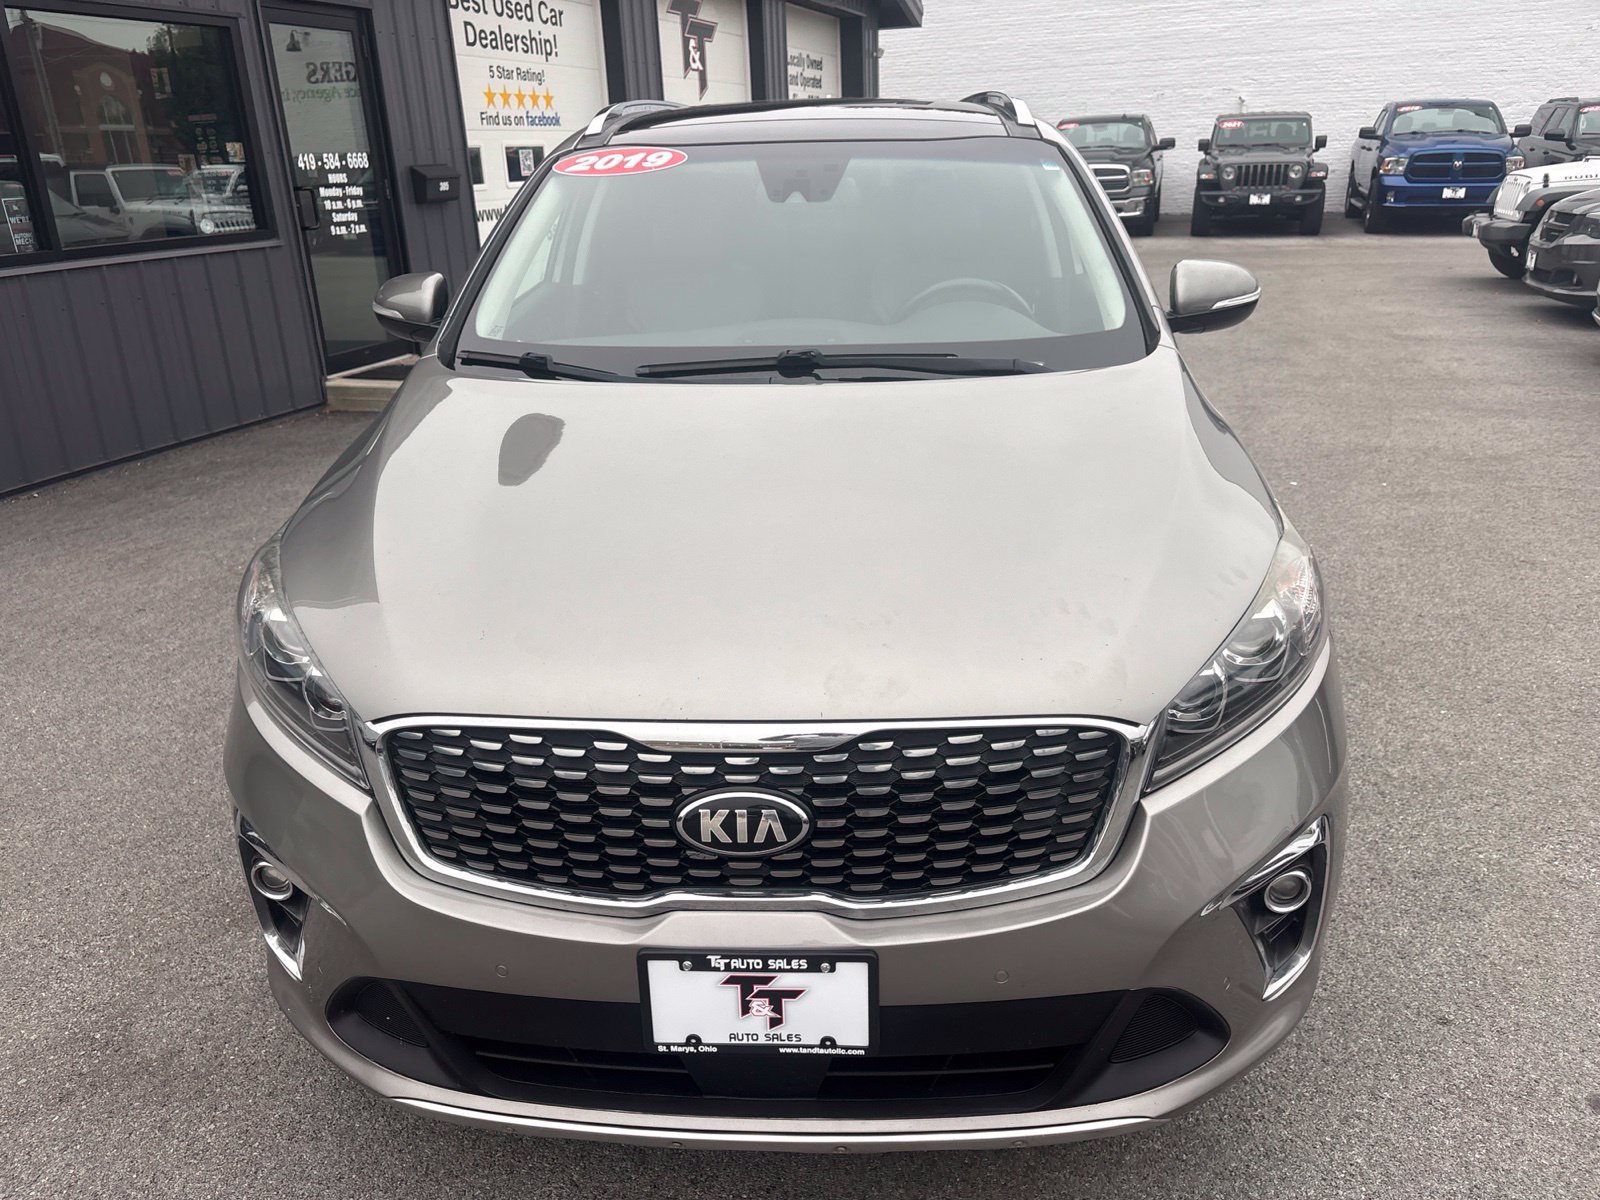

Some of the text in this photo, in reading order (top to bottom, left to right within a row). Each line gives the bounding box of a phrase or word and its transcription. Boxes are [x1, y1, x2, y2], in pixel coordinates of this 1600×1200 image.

[492, 0, 534, 22] Used
[538, 1, 564, 27] Car
[463, 20, 558, 62] Dealership!
[489, 65, 545, 86] 5 Star Rating!
[480, 111, 561, 127] Find us on facebook
[298, 152, 369, 170] 419 584 6668
[564, 151, 673, 172] 2019
[319, 187, 342, 197] Monday
[345, 186, 363, 196] Friday
[332, 212, 358, 222] Saturday
[698, 809, 788, 843] KIA
[730, 957, 763, 970] AUTO
[767, 958, 808, 970] SALES
[719, 974, 808, 1031] T&T
[729, 1033, 802, 1042] AUTO SALES
[670, 1045, 697, 1054] Marys,
[698, 1045, 718, 1053] Ohio
